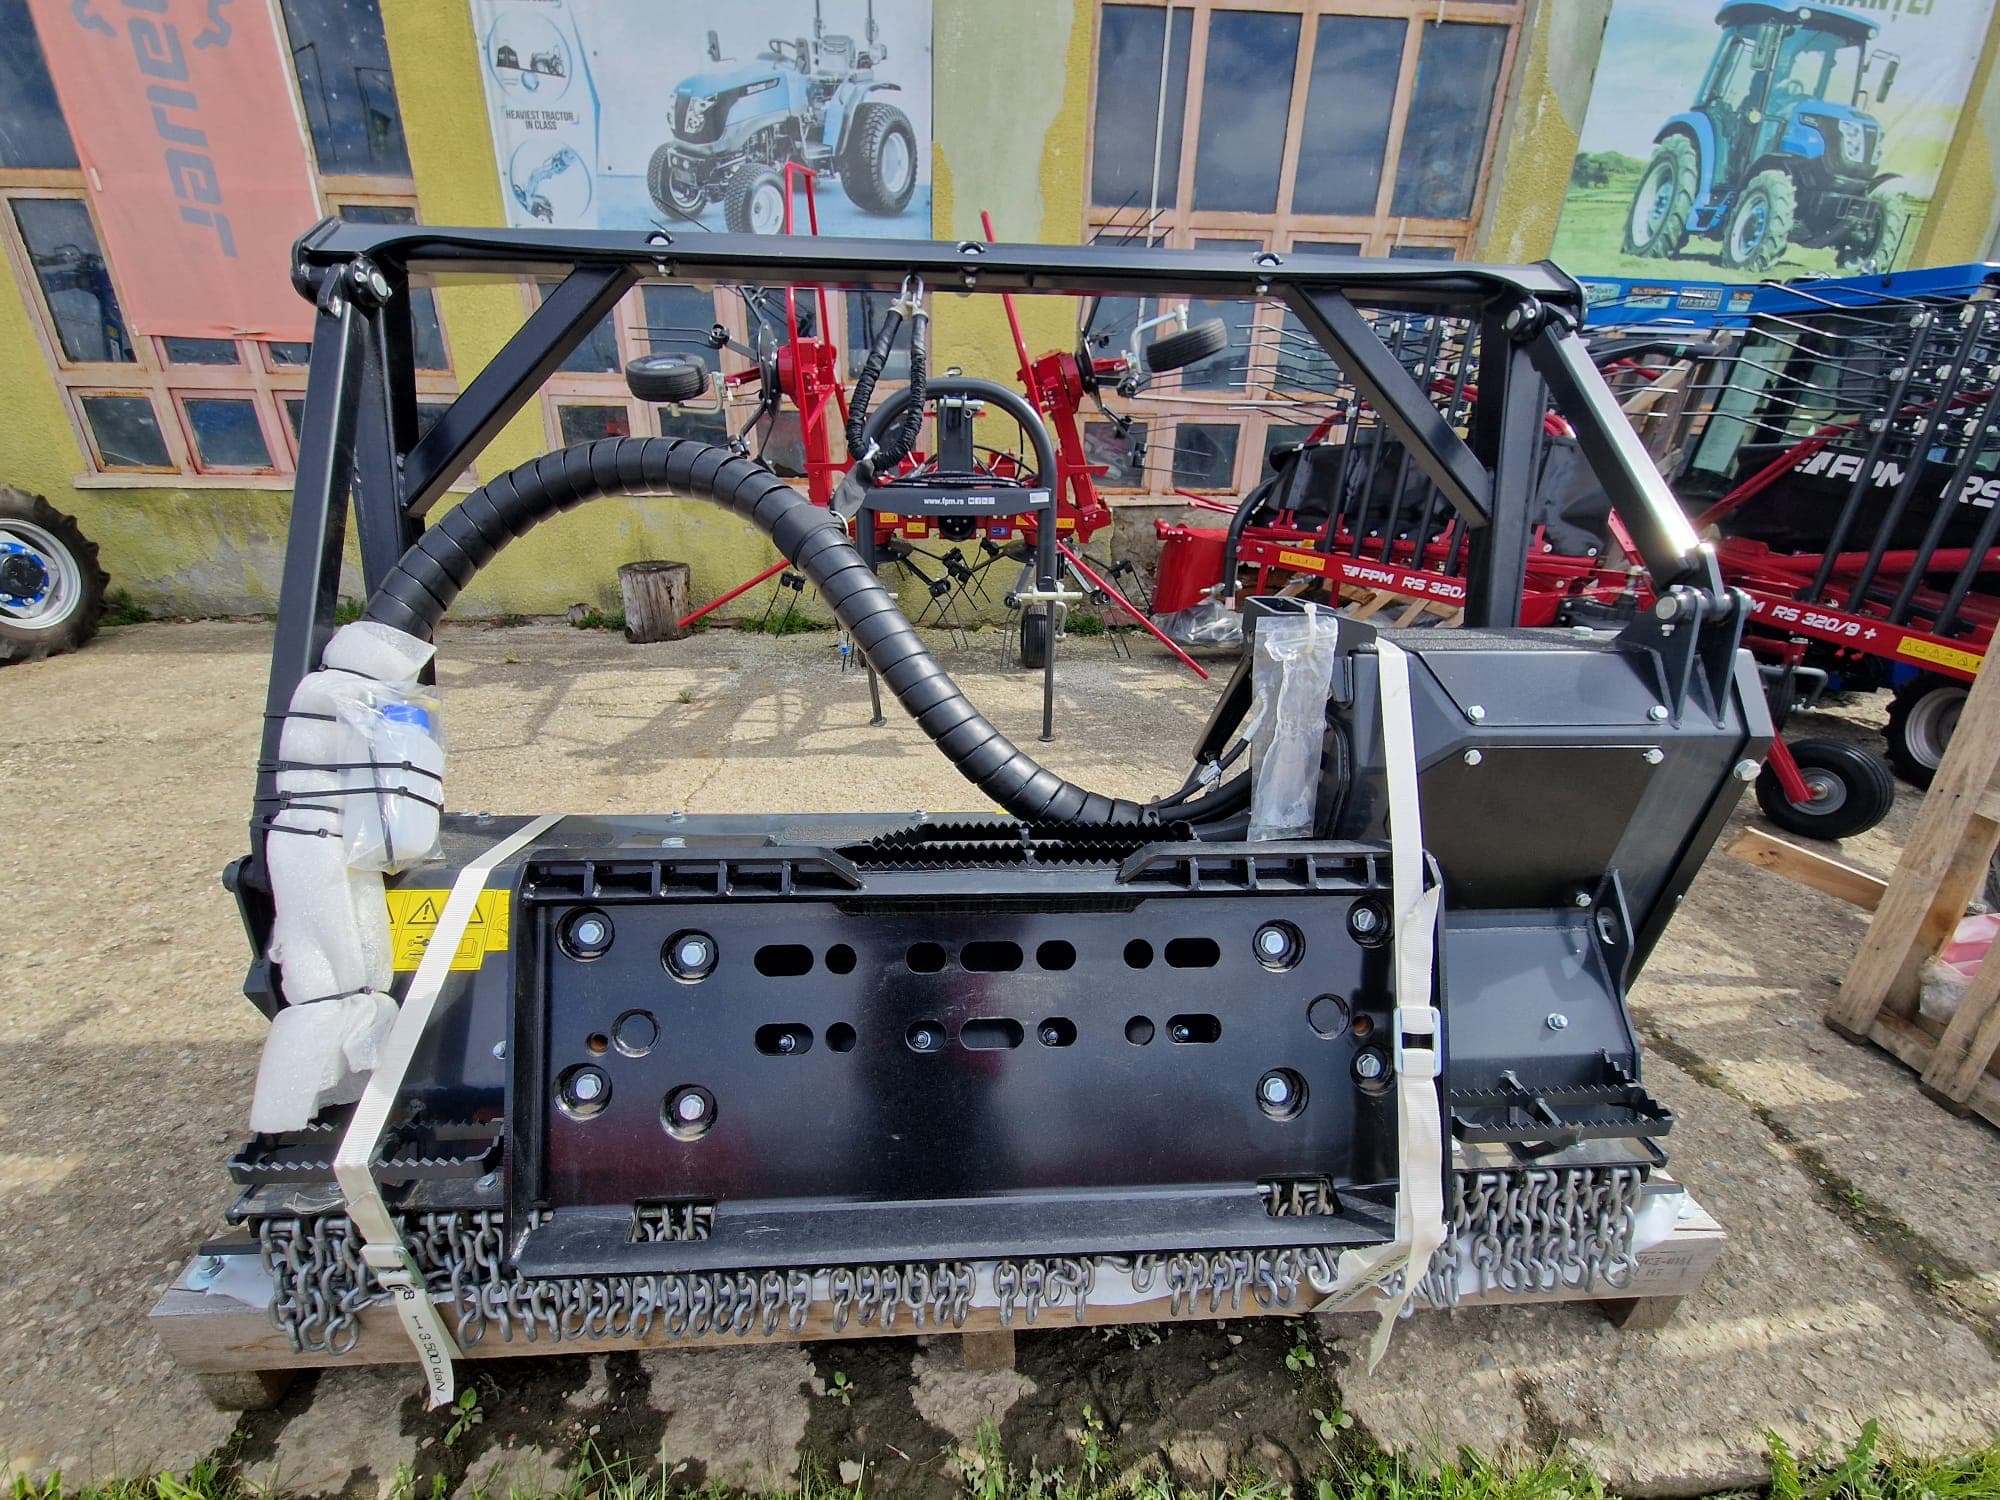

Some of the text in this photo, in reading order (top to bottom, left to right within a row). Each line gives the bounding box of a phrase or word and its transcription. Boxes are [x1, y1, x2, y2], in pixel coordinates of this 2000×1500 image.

[506, 110, 574, 121] HEAVIEST TRACTOR
[525, 120, 557, 130] IN CLASS
[122, 0, 239, 259] auer
[924, 497, 964, 506] www.fpm.rs
[1360, 567, 1395, 585] FPM
[1401, 576, 1427, 591] RS
[1771, 605, 1801, 621] RS
[1801, 613, 1861, 637] 320/9
[432, 1367, 446, 1392] daN
